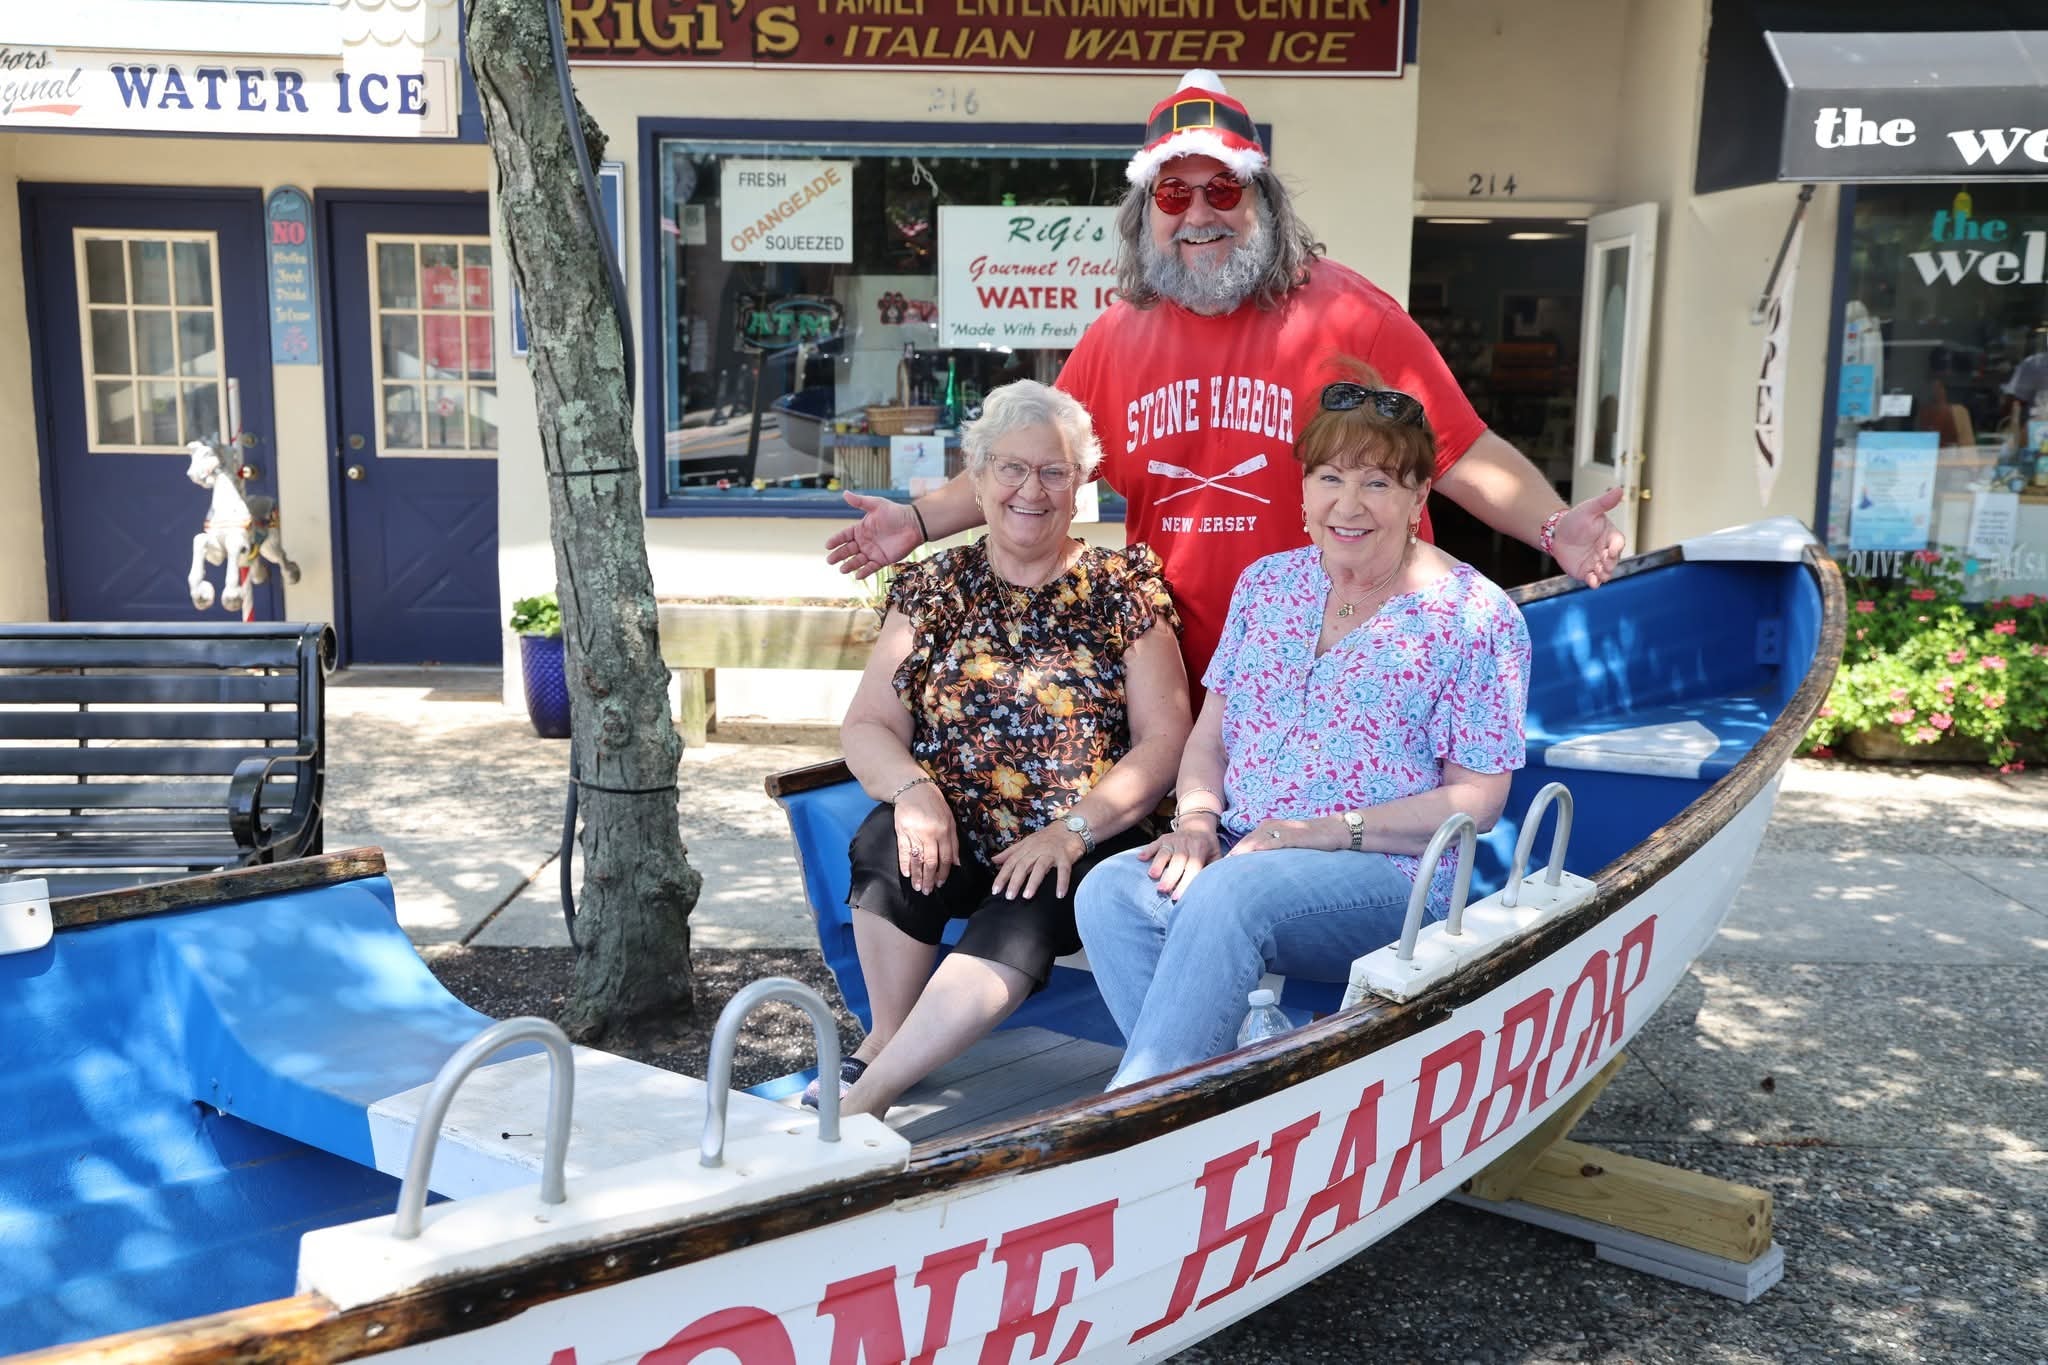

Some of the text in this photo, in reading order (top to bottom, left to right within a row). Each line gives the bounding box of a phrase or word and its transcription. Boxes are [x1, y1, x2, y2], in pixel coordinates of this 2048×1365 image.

[843, 25, 1356, 64] ITALIAN WATER ICE
[110, 64, 429, 117] WATER ICE
[1814, 107, 1917, 149] the
[738, 171, 787, 188] FRESH
[1468, 173, 1518, 196] 214
[730, 166, 842, 253] ORANGEADE
[271, 220, 307, 246] NO
[1008, 216, 1105, 252] RiGi's
[1931, 209, 2009, 243] the
[765, 235, 845, 251] SQUEEZED
[969, 256, 1058, 283] Gourmet
[976, 286, 1079, 310] WATER
[747, 311, 833, 337] ATM
[1004, 322, 1036, 337] With
[1041, 322, 1077, 337] Fresh
[1126, 375, 1294, 454] STONE HARBOR
[1161, 516, 1257, 533] NEW JERSEY
[1846, 549, 1905, 579] OLIVE
[1127, 913, 1658, 1346] HARBOR
